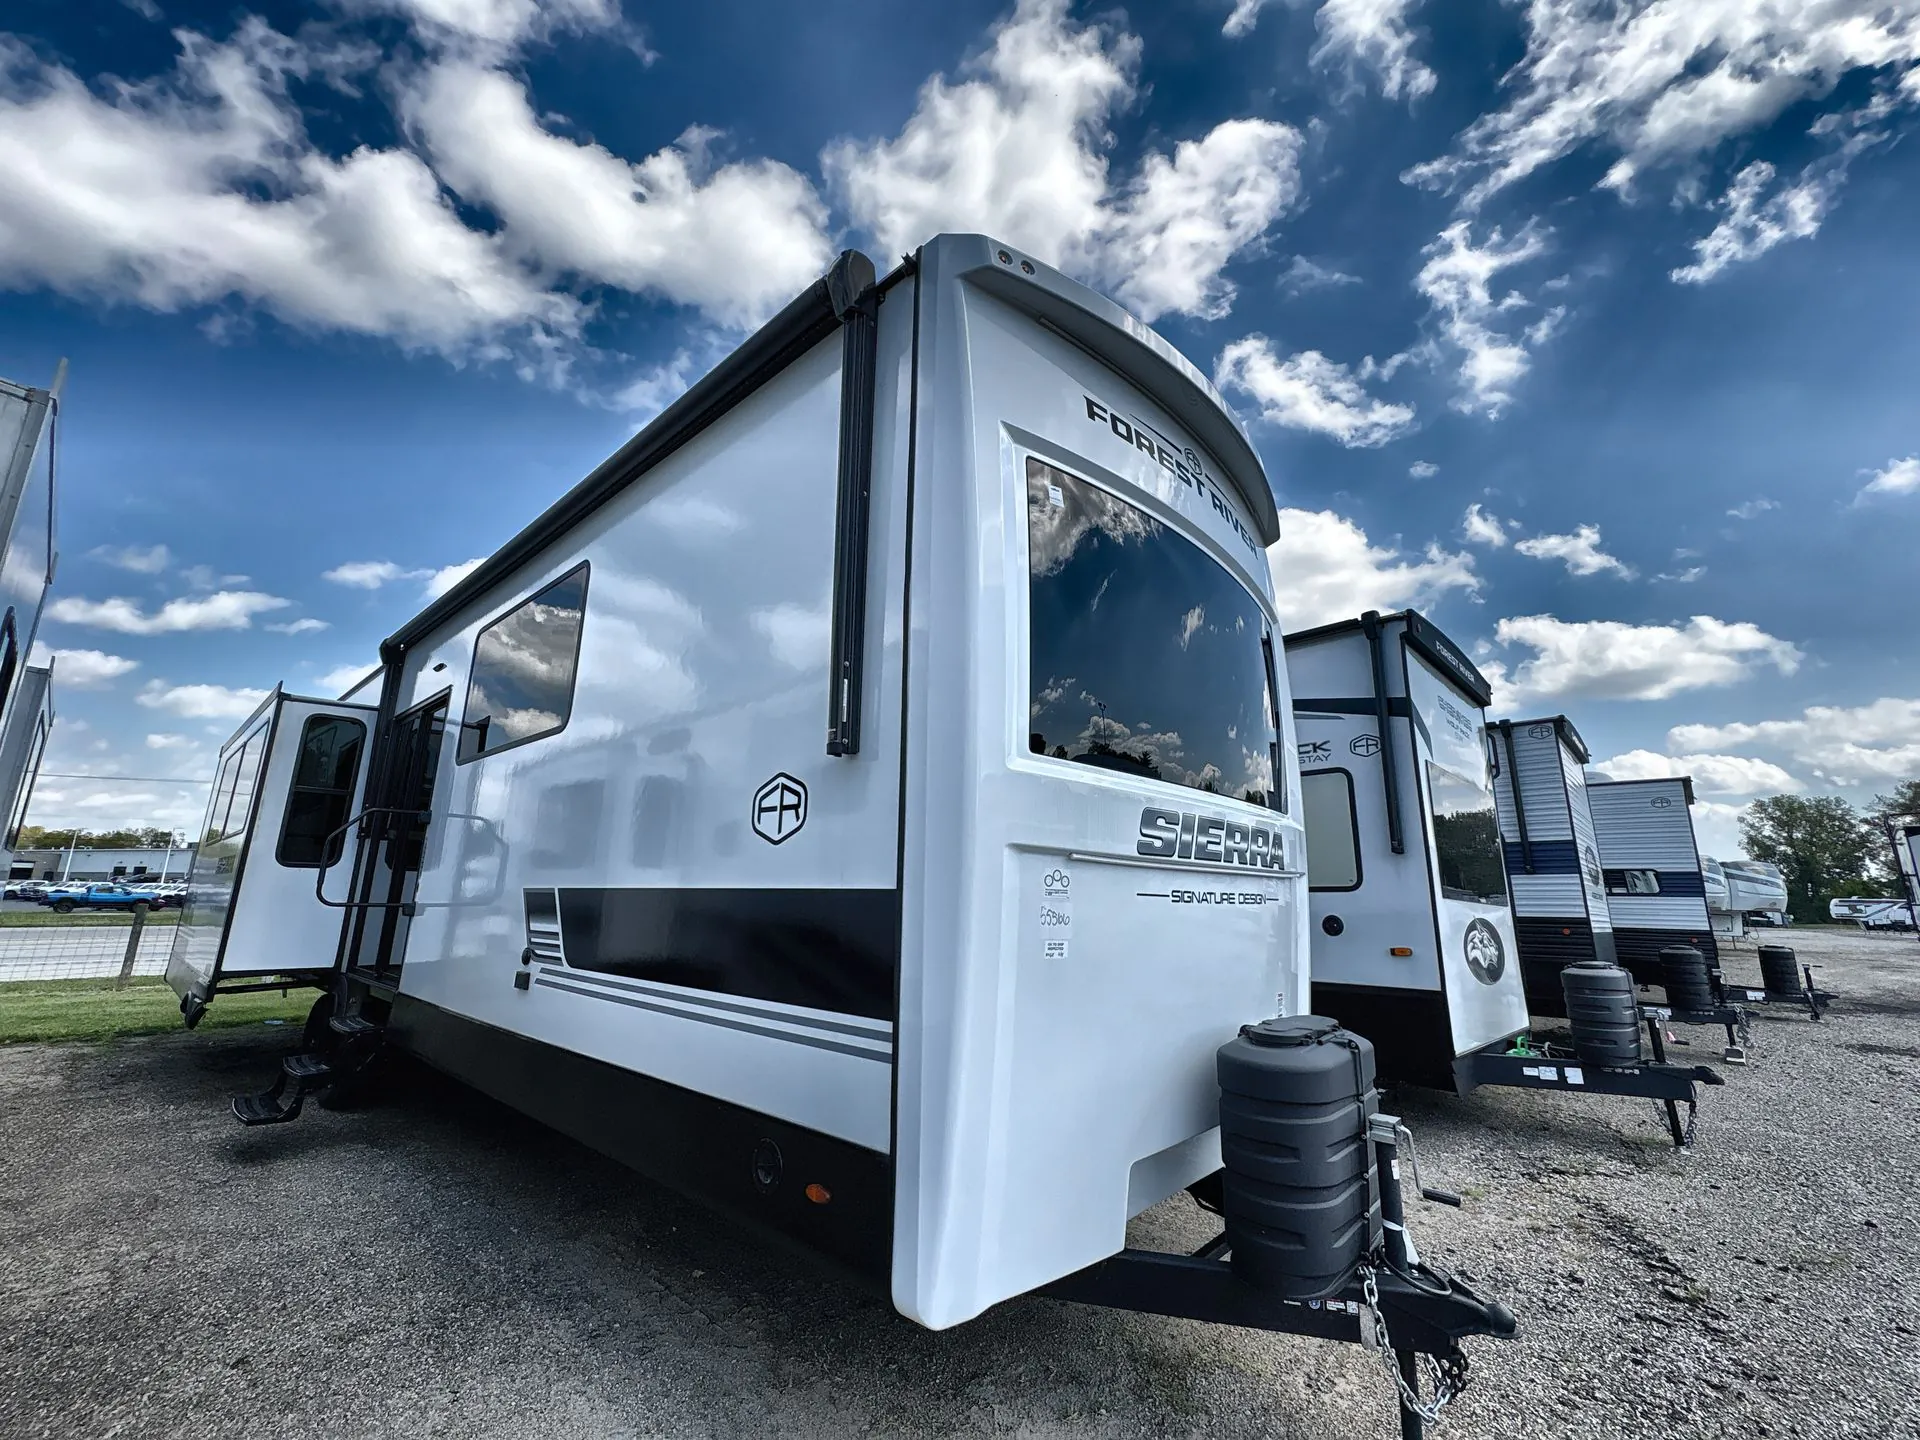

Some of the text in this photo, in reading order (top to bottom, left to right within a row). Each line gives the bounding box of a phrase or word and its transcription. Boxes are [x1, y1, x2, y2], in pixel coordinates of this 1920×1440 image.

[1083, 395, 1258, 560] FOREST RIVER
[1435, 640, 1475, 684] FOREST RIVER
[1298, 740, 1332, 755] CK
[1137, 807, 1285, 870] SIERRA
[1171, 890, 1236, 905] SIGNATURE
